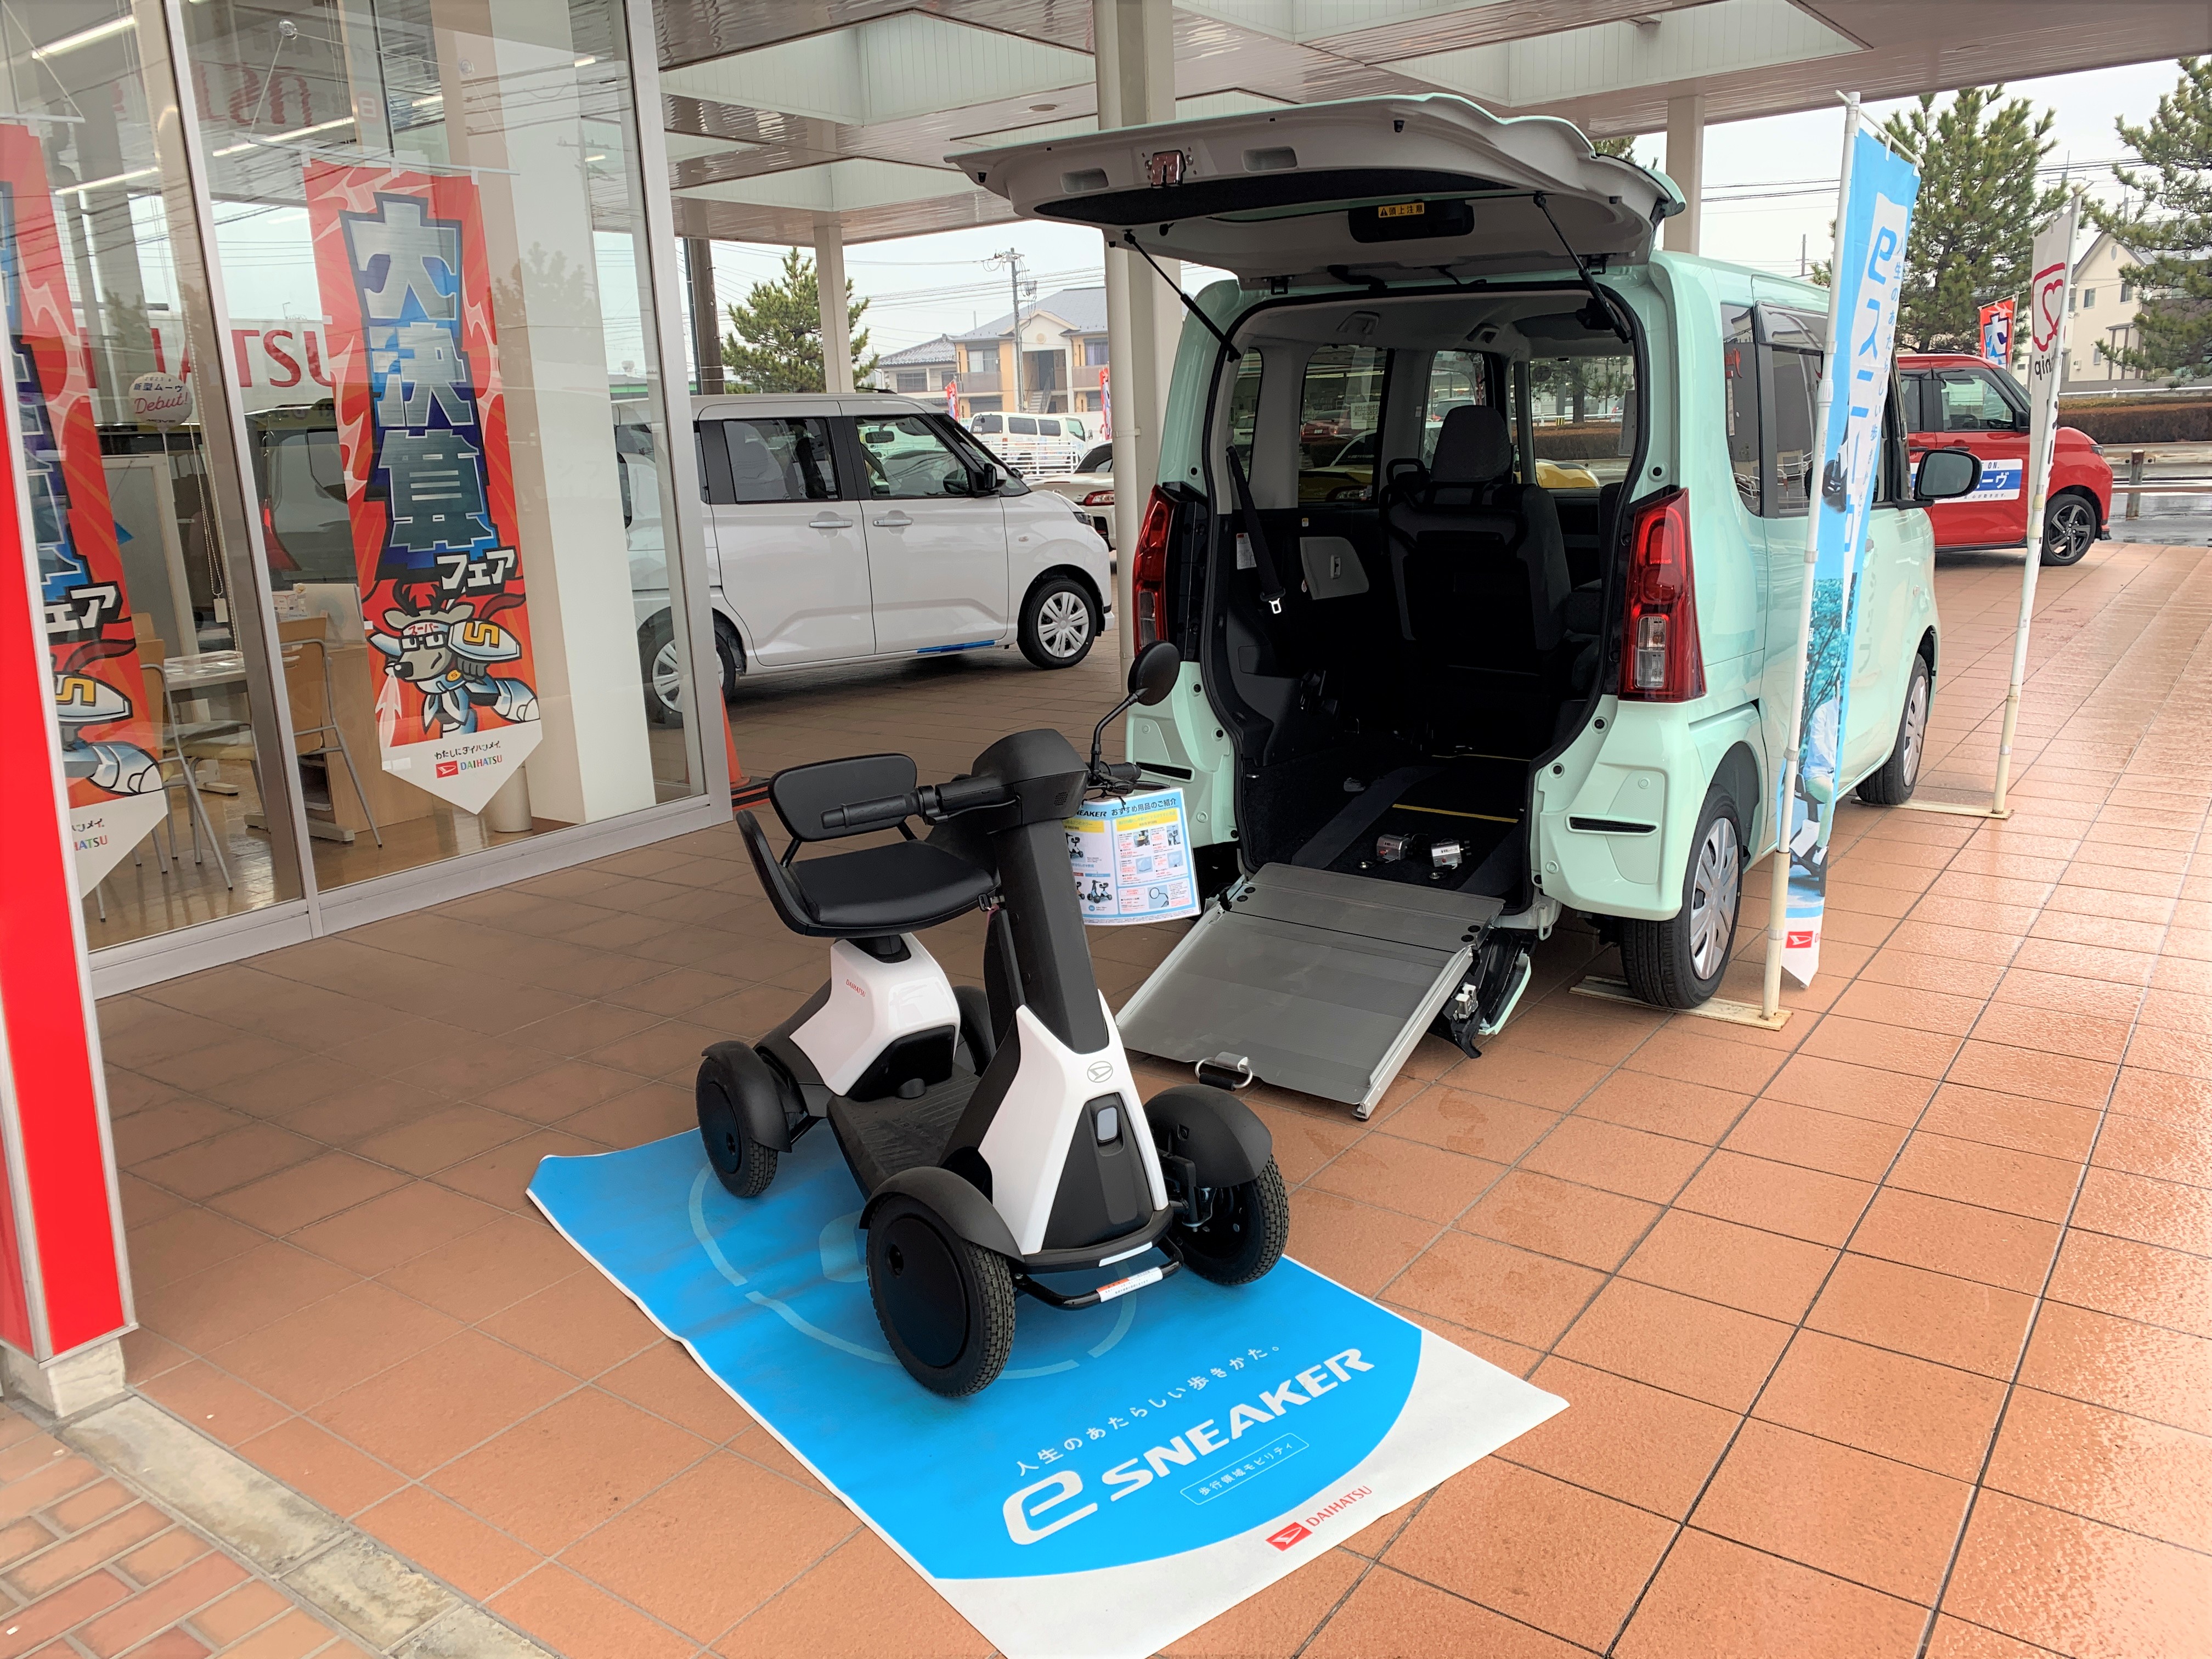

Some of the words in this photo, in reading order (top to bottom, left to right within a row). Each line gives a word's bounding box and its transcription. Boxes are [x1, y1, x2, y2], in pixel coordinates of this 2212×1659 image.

[1389, 204, 1423, 216] 頭上注意
[134, 392, 188, 414] Debut!
[437, 549, 516, 590] フェア
[45, 589, 117, 633] ェア
[460, 755, 503, 770] DAIHATSU
[1111, 798, 1177, 816] おすすめ用品のご紹介
[846, 979, 866, 997] DAIHATSU
[1016, 1343, 1280, 1477] 人生のあたらしい歩きかた。
[1102, 1348, 1375, 1501] SNEAKER
[1198, 1441, 1294, 1497] 歩行領域モビリティ
[1306, 1485, 1372, 1527] DAIHATSU
